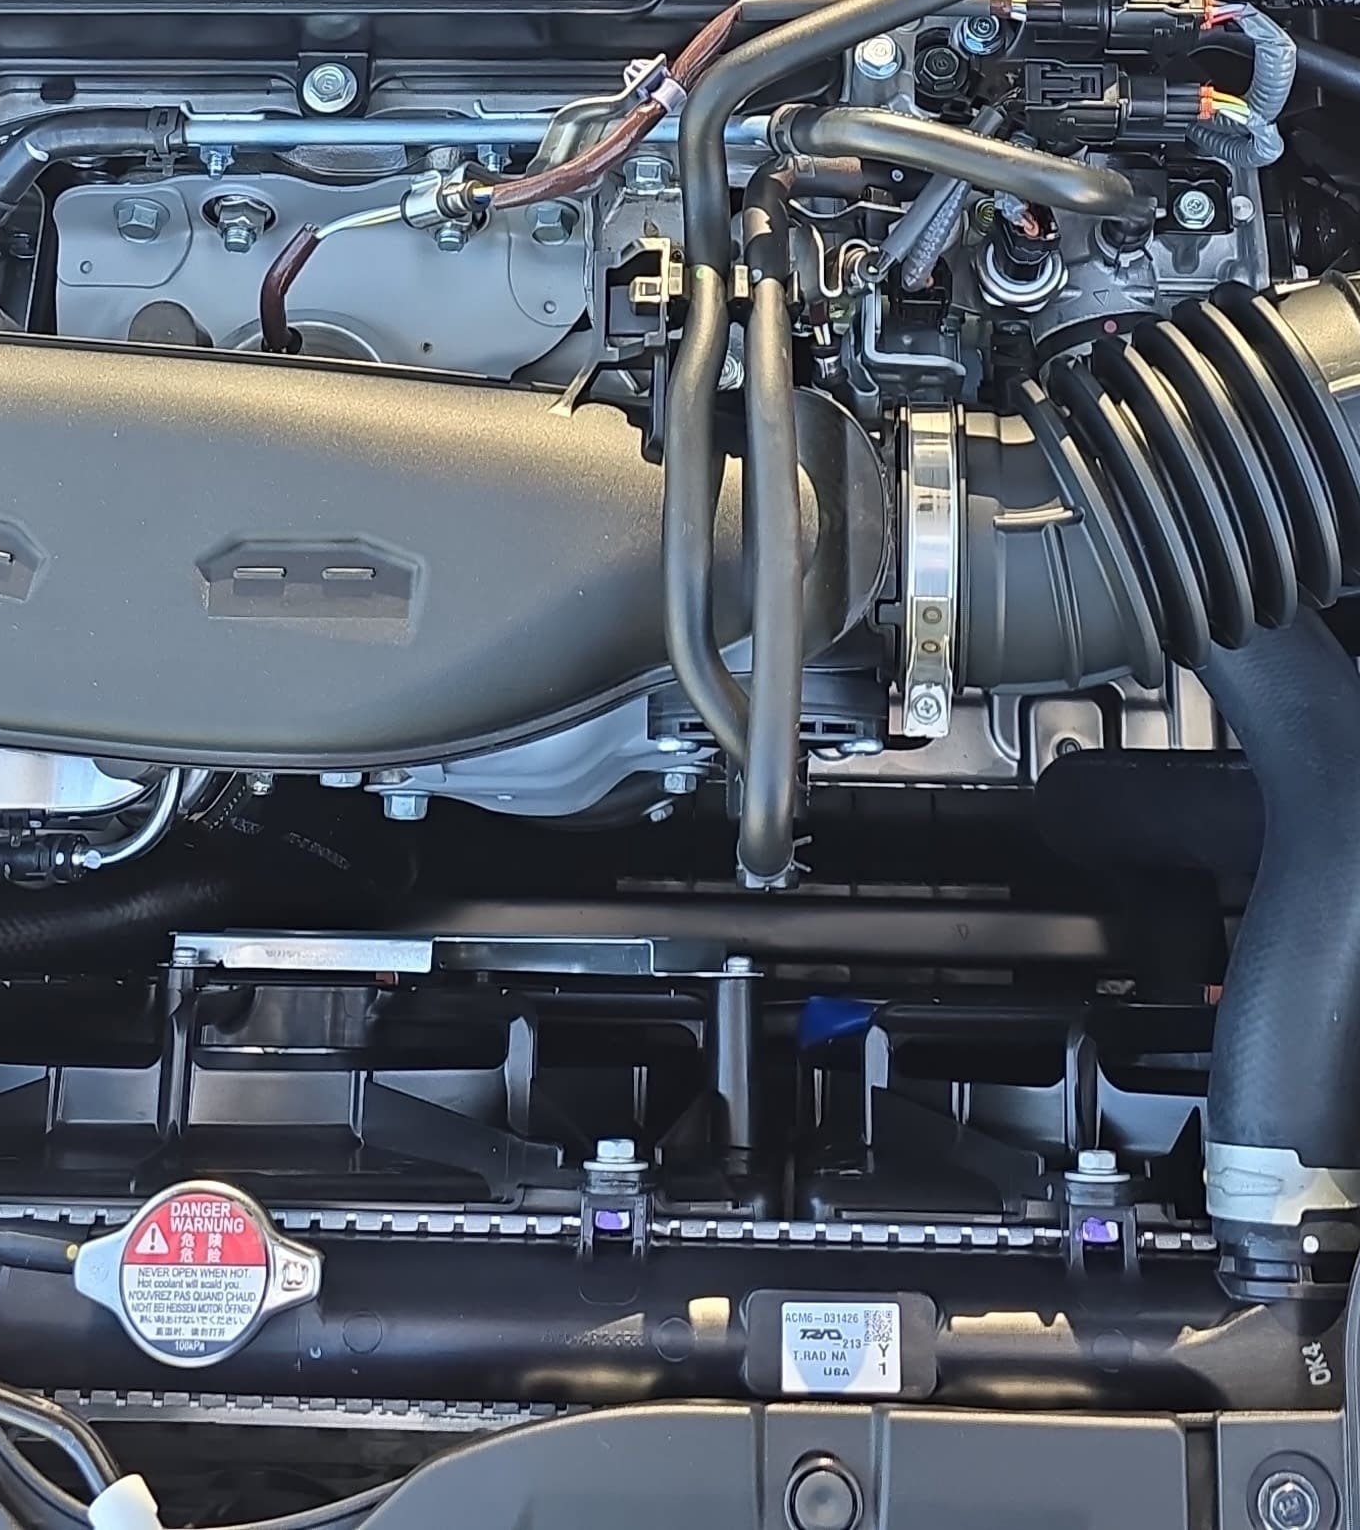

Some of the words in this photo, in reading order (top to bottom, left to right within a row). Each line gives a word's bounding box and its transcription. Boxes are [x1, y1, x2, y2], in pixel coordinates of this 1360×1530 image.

[170, 1201, 231, 1217] DANGER
[170, 1218, 245, 1233] WARNUNG
[138, 1267, 169, 1278] NEVER
[172, 1267, 198, 1278] OPEN
[200, 1267, 227, 1278] WHEN
[137, 1279, 152, 1289] Hot
[154, 1279, 184, 1289] coolant
[186, 1279, 198, 1289] will
[201, 1279, 222, 1289] scald
[128, 1291, 172, 1301] N'OUVREZ
[174, 1291, 191, 1301] PAS
[193, 1291, 223, 1301] QUAND
[131, 1303, 152, 1313] NICHT
[198, 1303, 223, 1313] MOTOR
[793, 1350, 827, 1361] T.RAD
[832, 1350, 847, 1361] NA
[878, 1343, 889, 1357] Y
[823, 1367, 850, 1376] USA
[878, 1363, 887, 1376] 1
